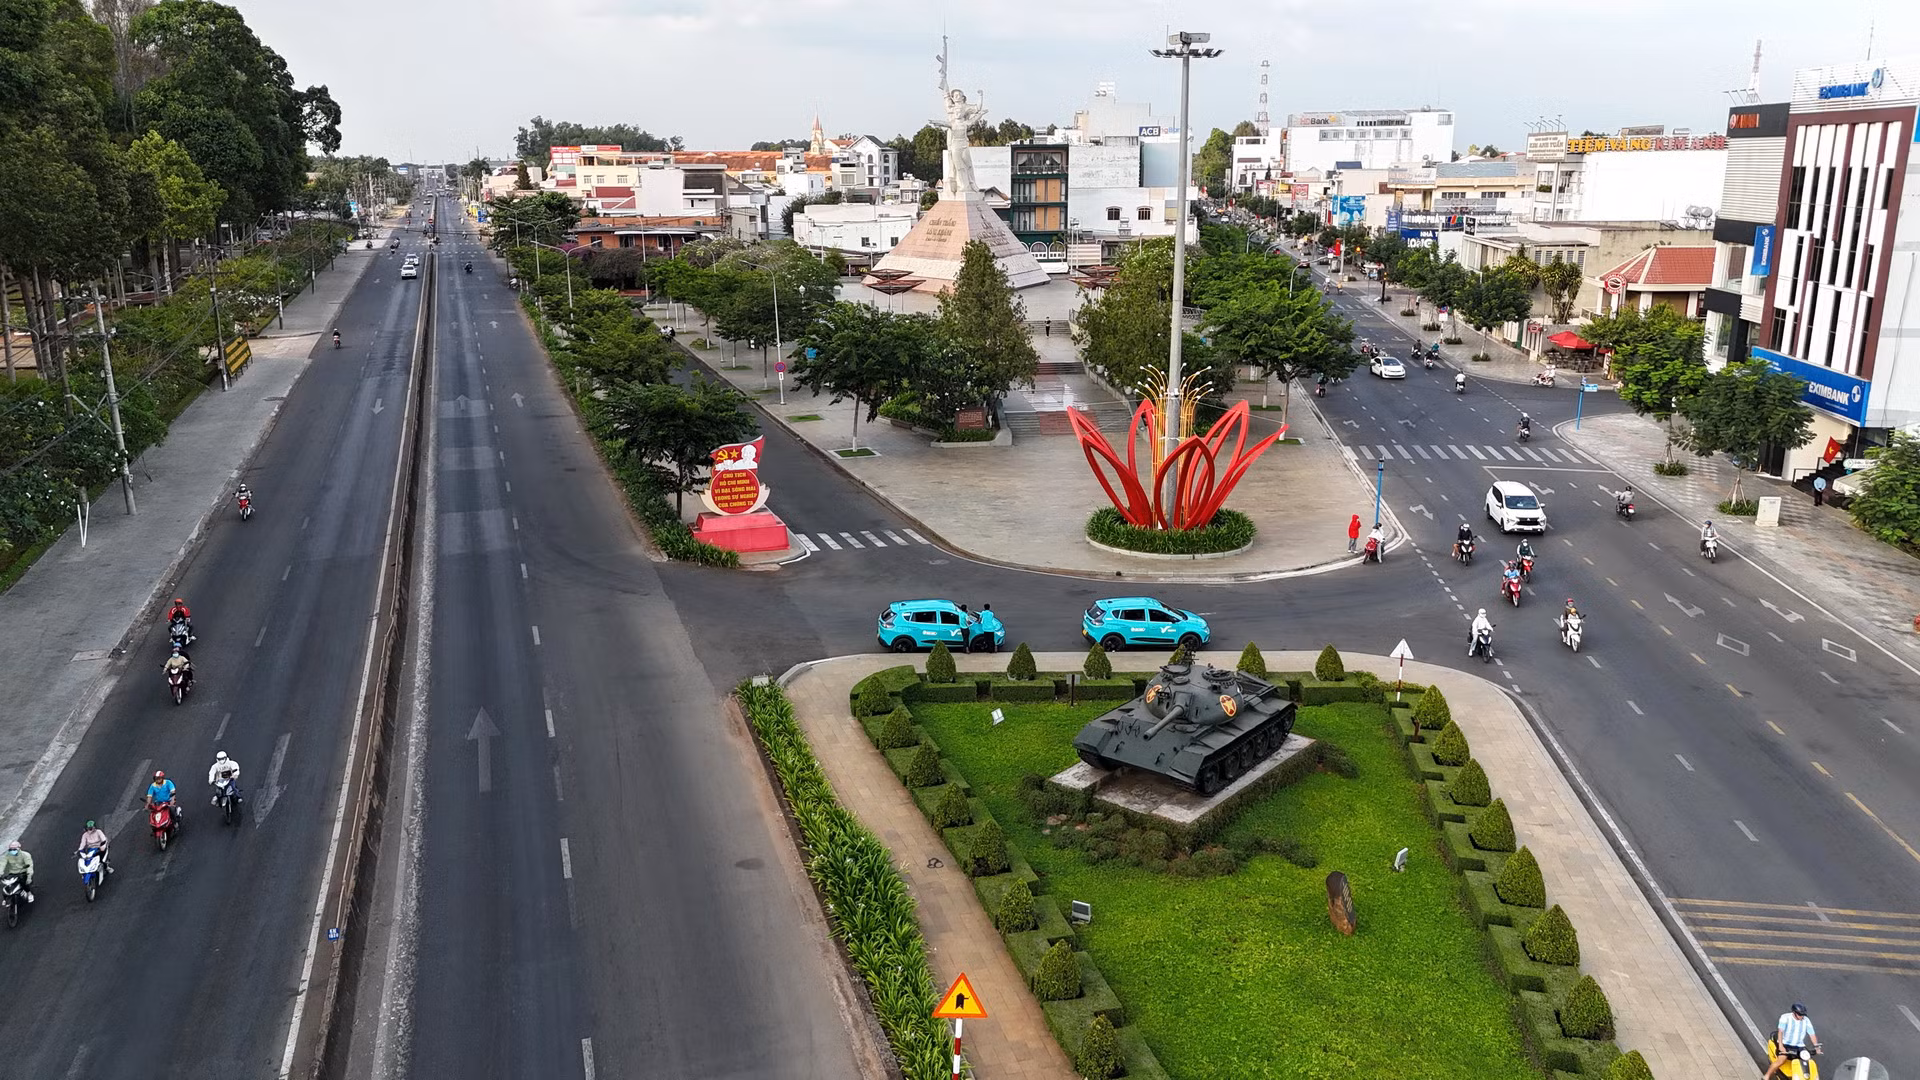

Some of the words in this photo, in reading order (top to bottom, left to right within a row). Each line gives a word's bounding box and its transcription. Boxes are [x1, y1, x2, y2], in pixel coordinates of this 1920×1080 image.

[1140, 127, 1159, 136] ACB
[1608, 133, 1652, 151] VÀNG
[1654, 136, 1690, 151] KIM
[1691, 136, 1726, 151] ANH
[1808, 381, 1850, 405] EXIMBANK
